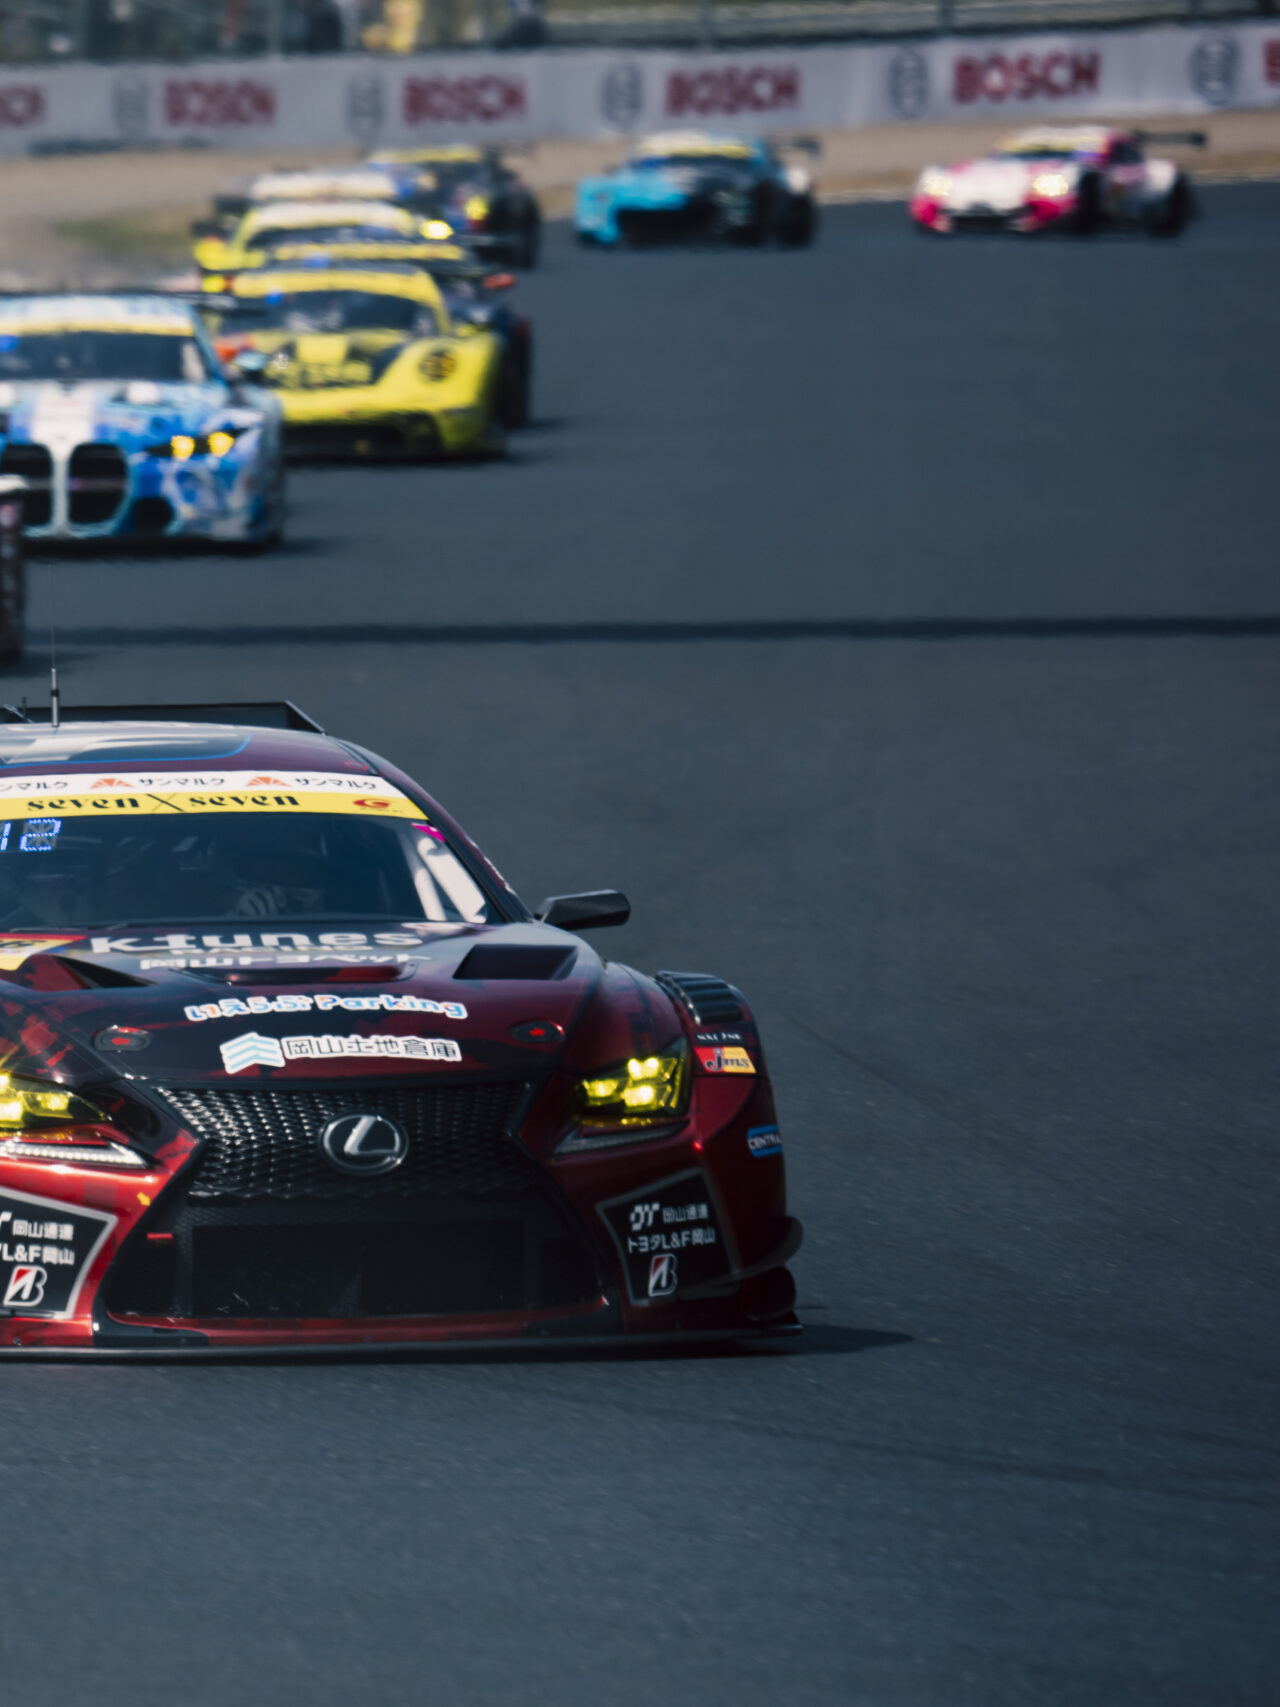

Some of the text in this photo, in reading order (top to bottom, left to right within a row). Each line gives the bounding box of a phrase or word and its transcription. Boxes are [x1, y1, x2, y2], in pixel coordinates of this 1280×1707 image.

[953, 51, 1101, 103] BOSCH
[403, 74, 528, 126] BOSCH
[666, 65, 800, 116] BOSCH
[139, 775, 225, 788] サンマルク
[295, 777, 376, 790] サンマルク
[27, 797, 140, 811] seven
[188, 794, 300, 807] seven
[314, 996, 467, 1019] Parking
[285, 1038, 460, 1059] 岡山土地倉庫
